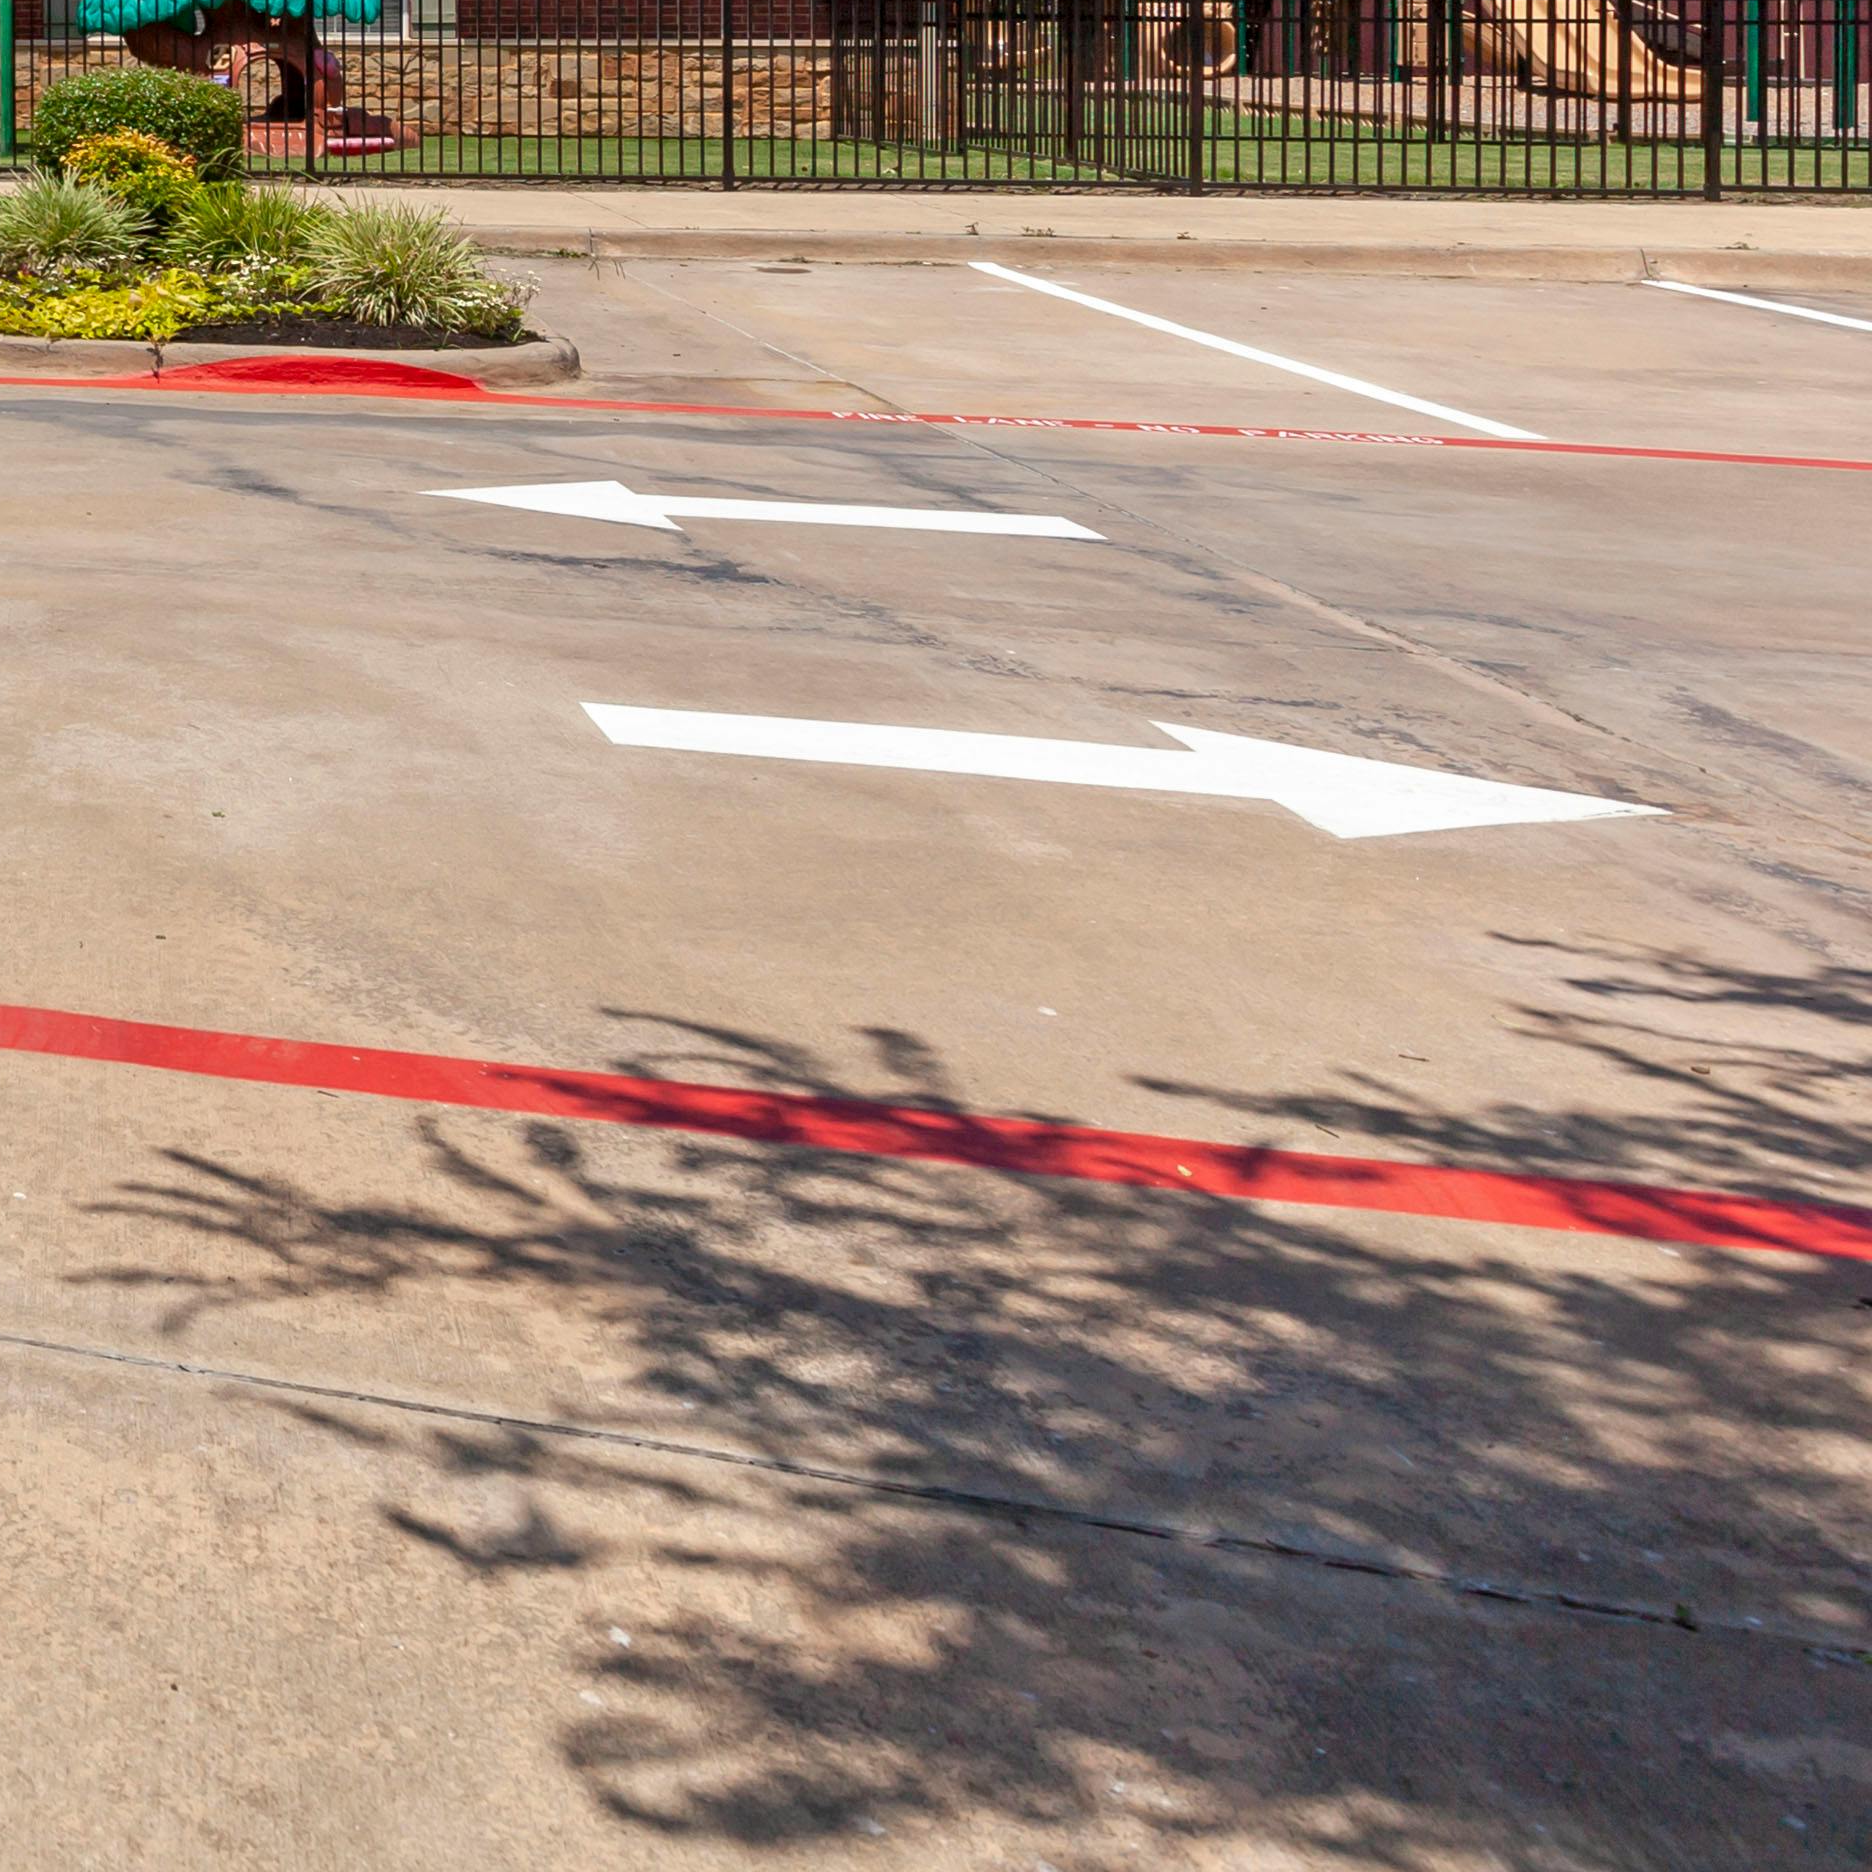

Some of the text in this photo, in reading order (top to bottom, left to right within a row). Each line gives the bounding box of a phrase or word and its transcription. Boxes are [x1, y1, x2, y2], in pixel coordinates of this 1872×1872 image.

[832, 411, 924, 422] FIRE
[953, 415, 1073, 427] LANE
[1136, 423, 1201, 434] NO
[1237, 428, 1444, 445] PARKING
